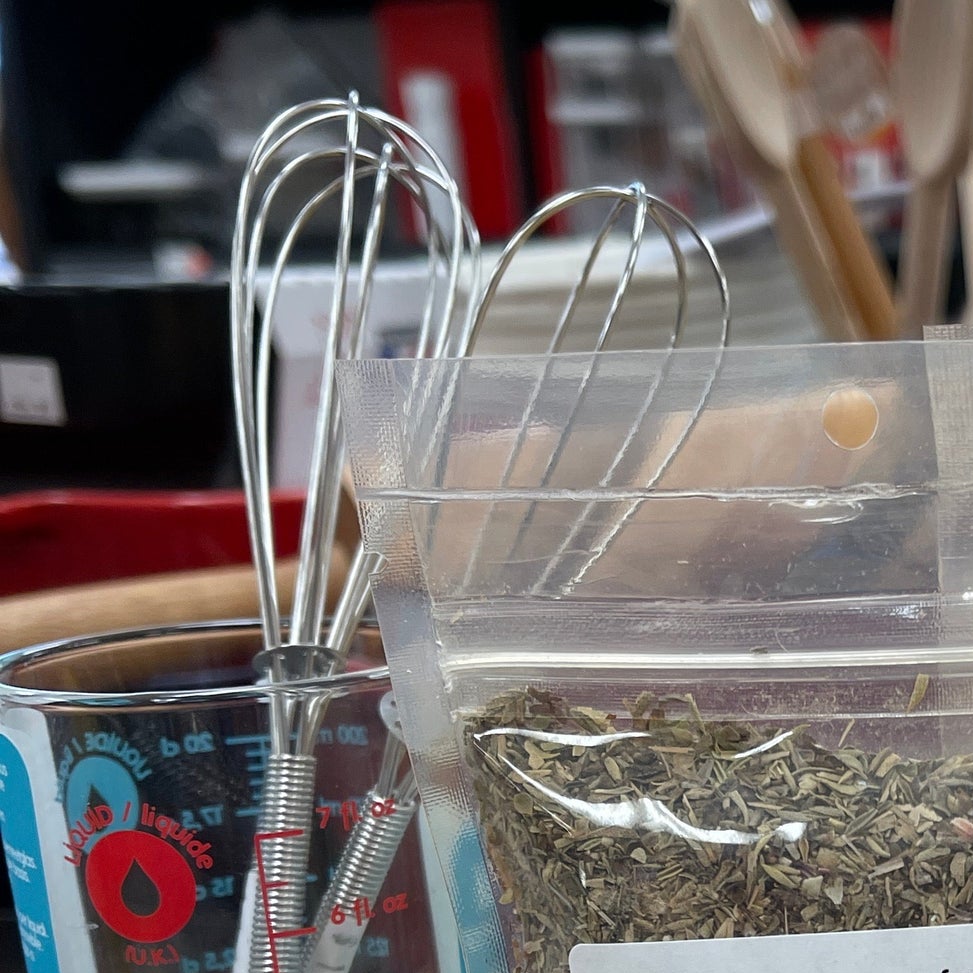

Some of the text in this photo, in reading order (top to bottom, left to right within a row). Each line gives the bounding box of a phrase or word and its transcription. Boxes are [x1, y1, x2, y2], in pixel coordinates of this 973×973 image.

[315, 806, 331, 829] 7
[340, 800, 363, 832] fl.
[371, 798, 397, 818] oz
[64, 804, 114, 867] LIQUID
[141, 803, 214, 870] liquide
[330, 892, 408, 927] 6 fl. oz
